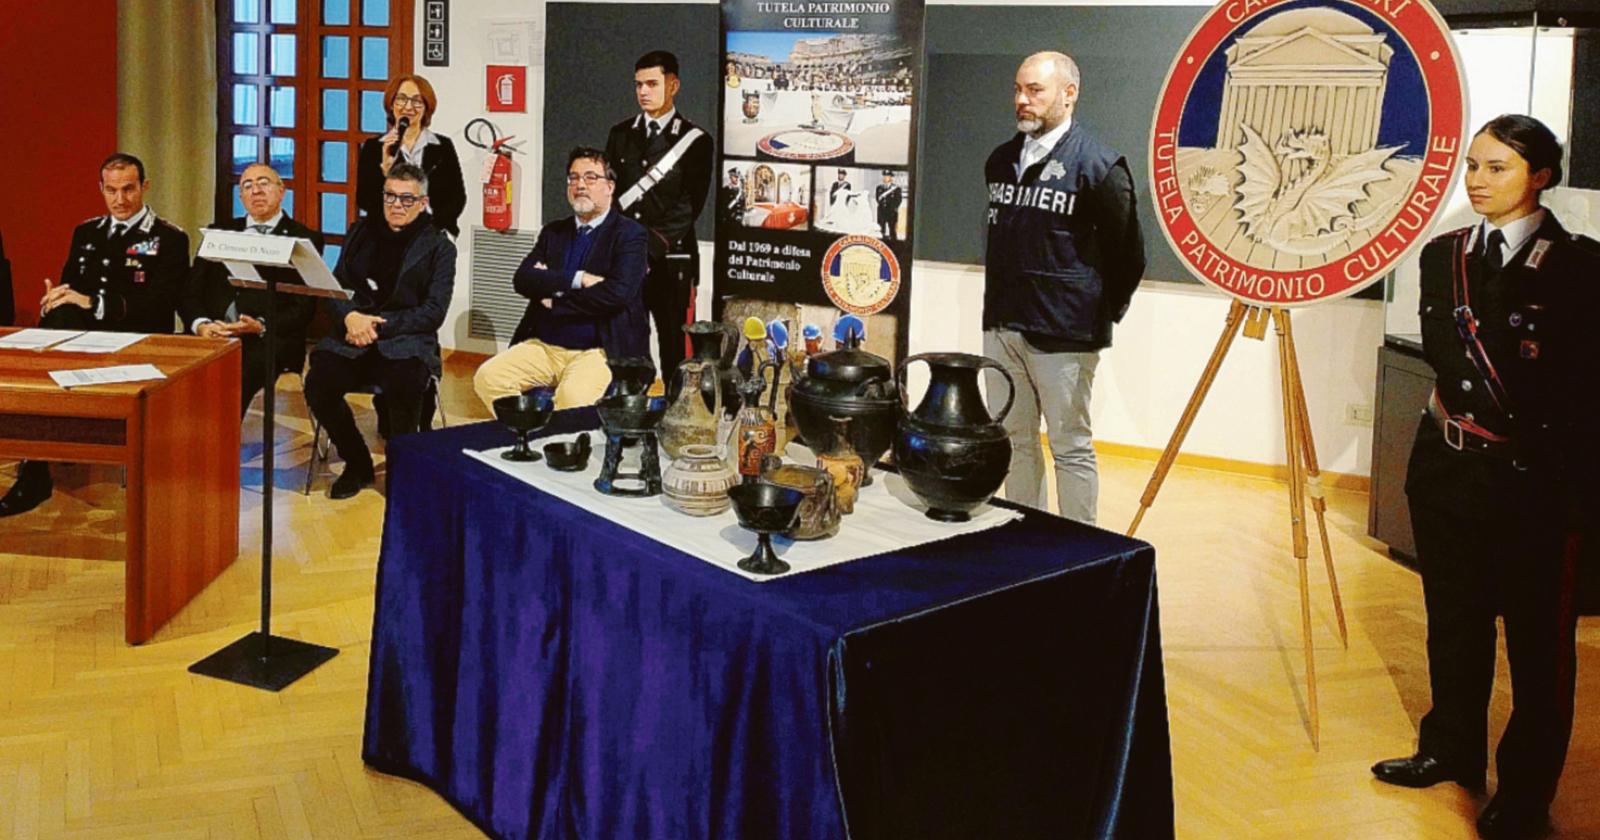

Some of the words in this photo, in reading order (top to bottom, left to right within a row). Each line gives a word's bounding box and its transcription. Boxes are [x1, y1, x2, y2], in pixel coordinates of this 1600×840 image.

[757, 2, 805, 13] TUTELA
[808, 2, 890, 14] PATRIMONIO
[783, 17, 859, 29] CULTURALE
[1157, 127, 1183, 224] TUTELA
[1181, 230, 1325, 299] PATRIMONIO
[1343, 135, 1457, 281] CULTURALE
[728, 240, 746, 252] Dal
[748, 241, 772, 254] 1969
[773, 246, 780, 254] a
[781, 245, 811, 258] difesa
[728, 254, 744, 265] del
[745, 255, 802, 271] Patrimonio
[727, 268, 776, 283] Culturale
